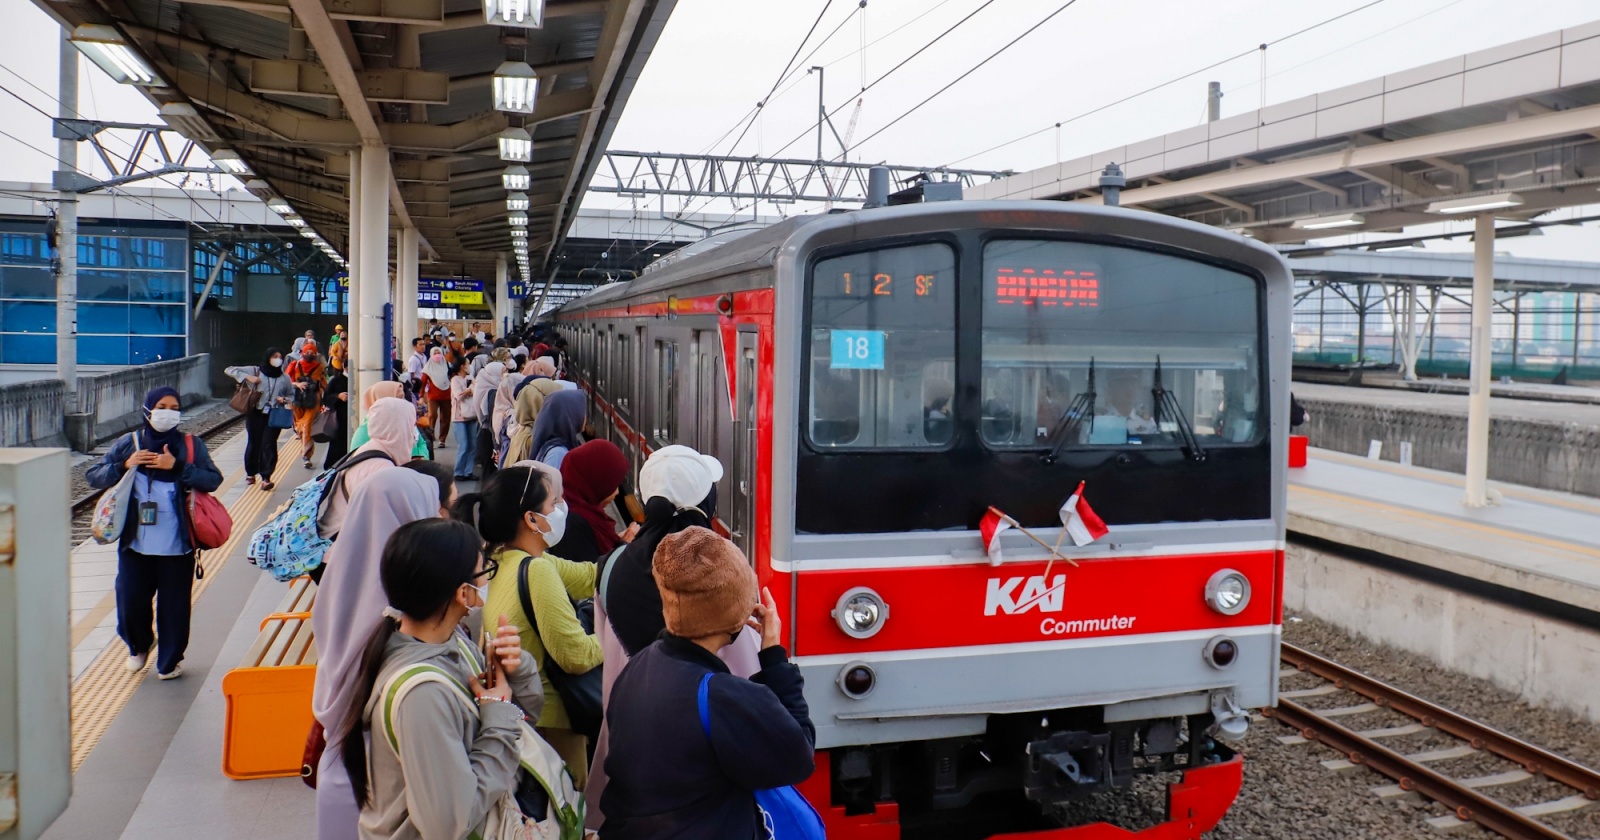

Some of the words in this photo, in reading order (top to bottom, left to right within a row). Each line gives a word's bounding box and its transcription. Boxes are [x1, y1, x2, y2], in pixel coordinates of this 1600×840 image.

[511, 285, 522, 295] 11
[843, 272, 851, 294] 1
[873, 272, 891, 295] 2
[915, 274, 934, 296] SF
[845, 336, 869, 359] 18
[983, 574, 1067, 616] KAI
[1040, 614, 1137, 635] Commuter
